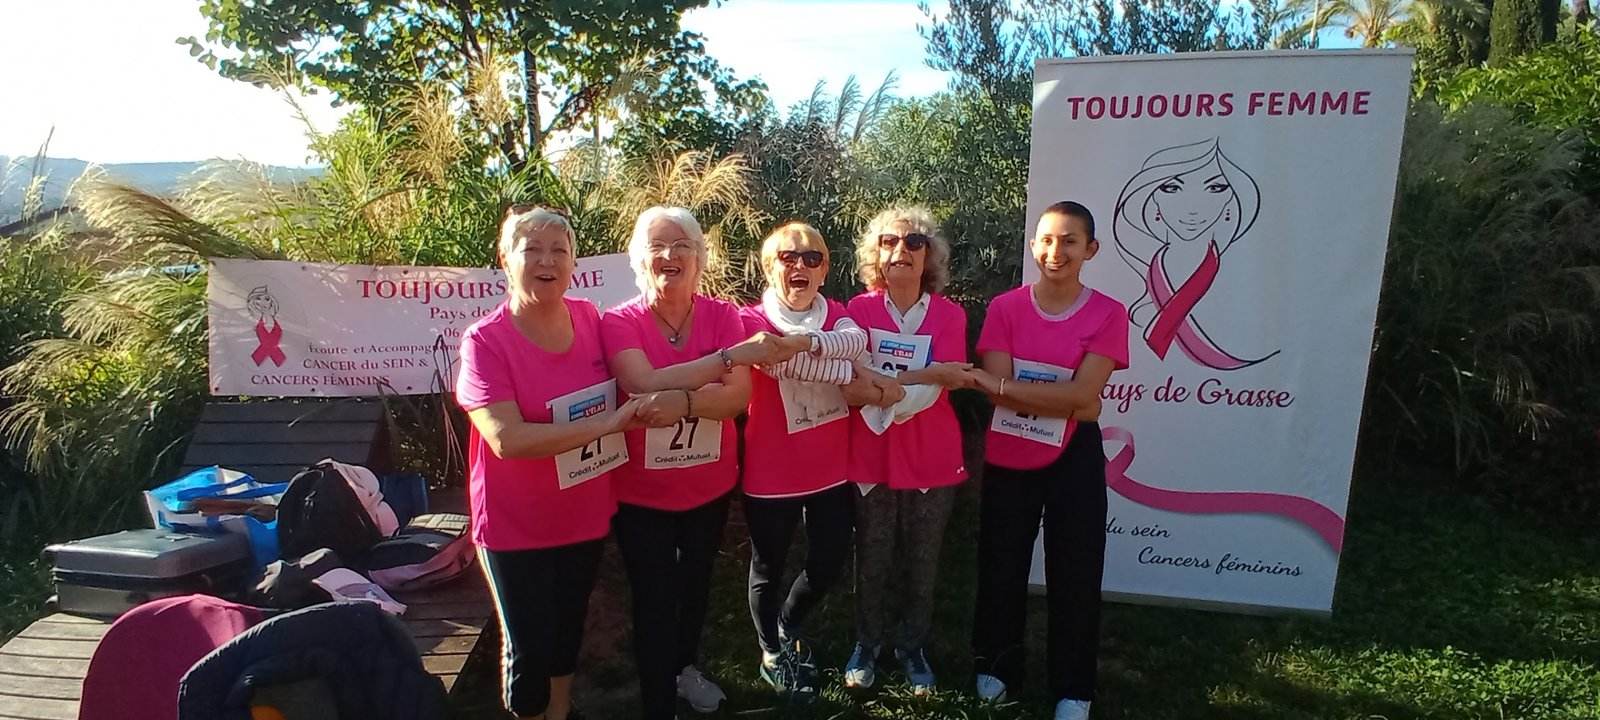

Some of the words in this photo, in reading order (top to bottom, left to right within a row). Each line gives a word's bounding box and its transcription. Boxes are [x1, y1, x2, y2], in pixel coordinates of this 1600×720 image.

[1067, 93, 1234, 120] TOUJOURS
[1248, 91, 1372, 116] FEMME
[356, 279, 507, 305] TOUJOURS
[430, 306, 466, 324] Pays
[471, 306, 490, 318] de
[353, 345, 365, 354] et
[303, 359, 356, 370] CANCER
[361, 359, 379, 370] du
[383, 358, 414, 370] SEIN
[418, 359, 428, 367] &
[251, 374, 319, 386] CANCERS
[1100, 383, 1148, 413] ays
[1154, 376, 1191, 402] de
[1197, 378, 1295, 408] Grasse
[670, 416, 700, 450] 27
[1131, 524, 1171, 538] sein
[1138, 546, 1211, 568] Cancers
[1215, 553, 1304, 577] féminins
